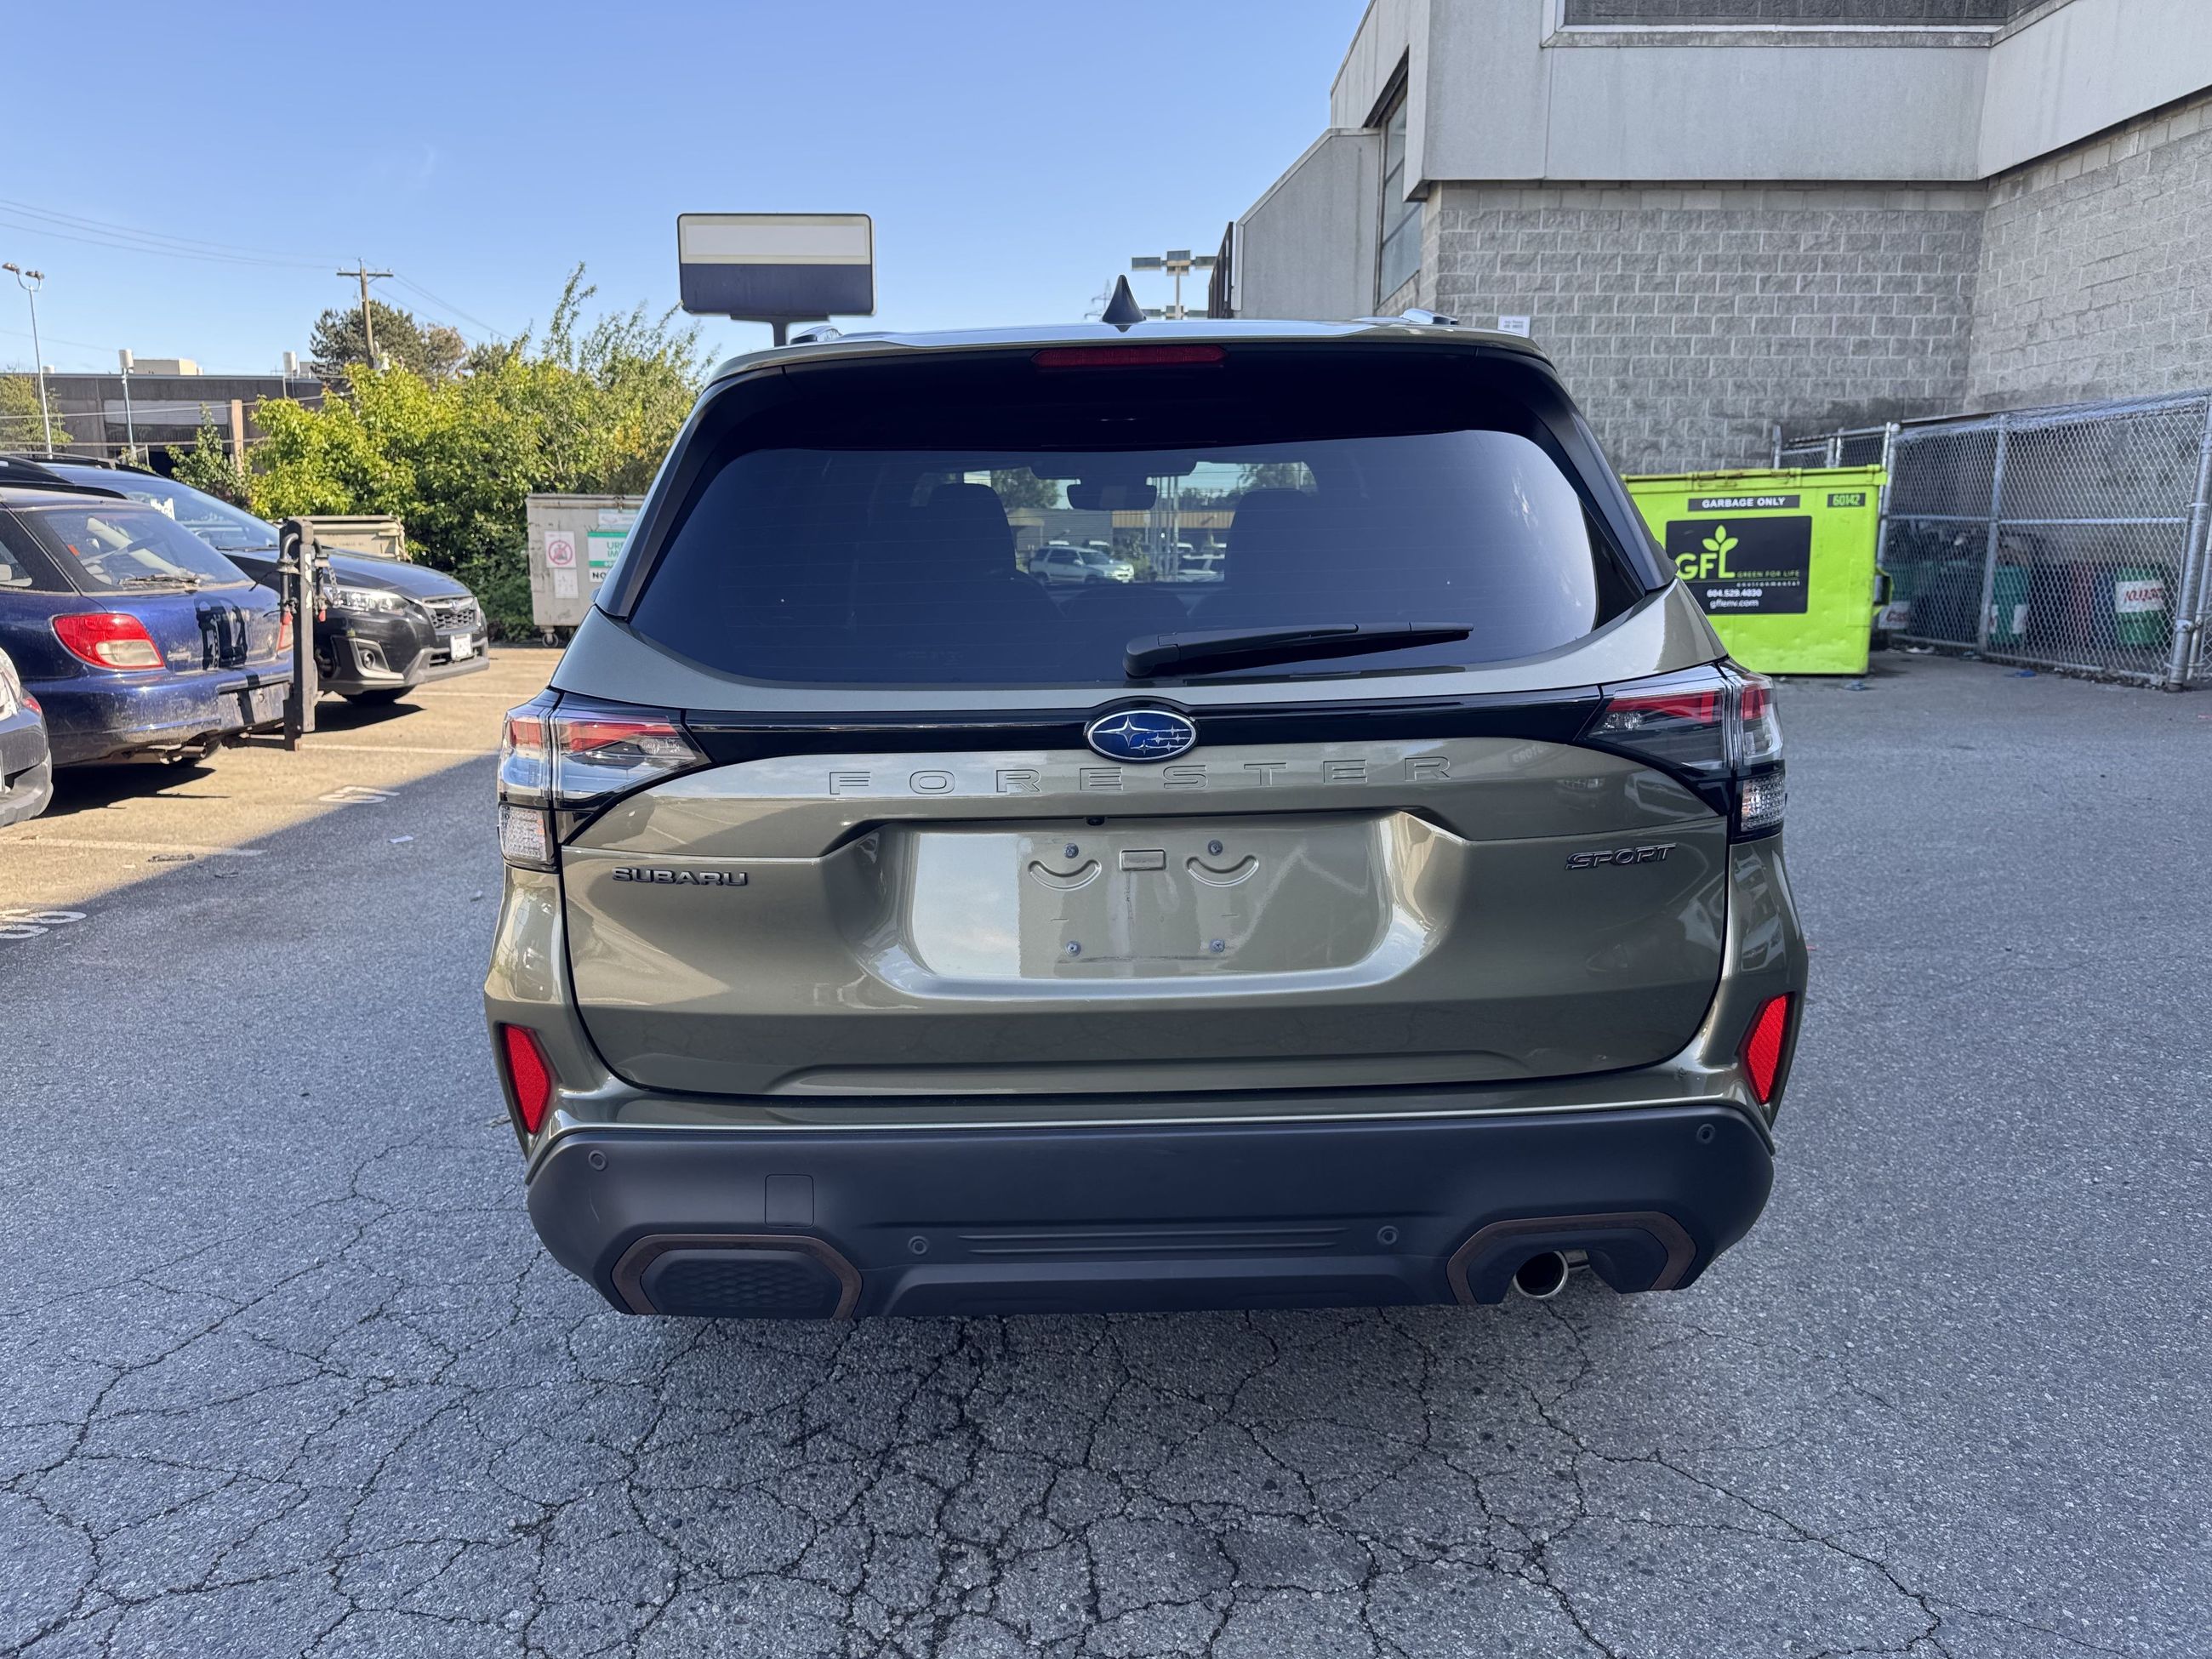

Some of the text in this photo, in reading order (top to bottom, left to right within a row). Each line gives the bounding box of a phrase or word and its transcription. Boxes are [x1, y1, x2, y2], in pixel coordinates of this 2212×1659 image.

[1702, 496, 1787, 509] GARBAGE ONLY
[1833, 493, 1861, 506] 60142
[1674, 538, 1739, 580] GFL
[1736, 570, 1764, 579] GREEN
[1782, 569, 1800, 578] LIFE
[828, 755, 1452, 795] FORESTER
[1565, 842, 1678, 870] SPORT
[611, 866, 749, 887] SUBARU
